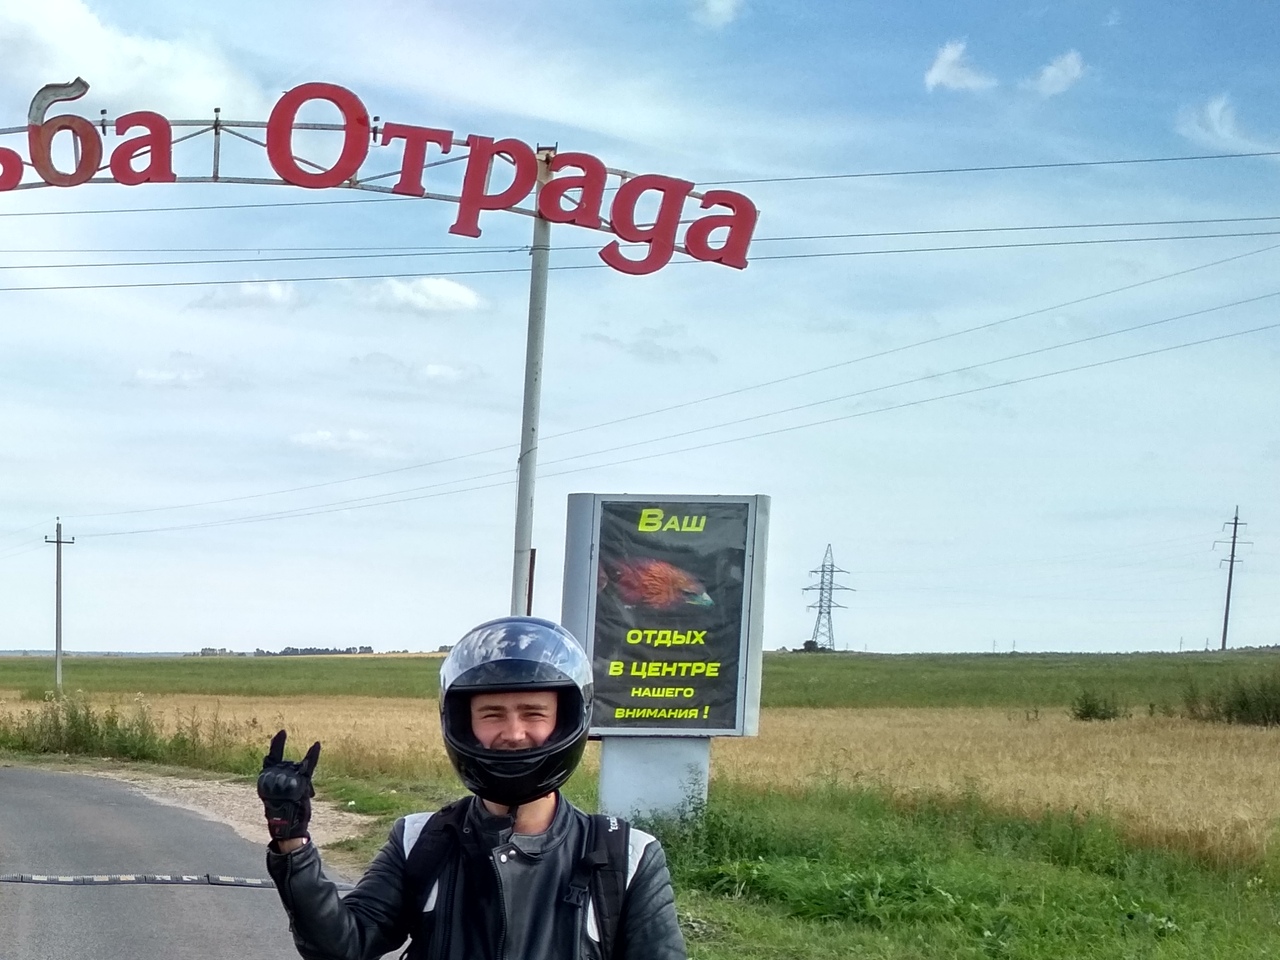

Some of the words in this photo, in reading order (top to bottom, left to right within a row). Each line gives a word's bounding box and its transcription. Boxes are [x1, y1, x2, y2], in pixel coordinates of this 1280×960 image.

[266, 82, 759, 275] Отрада
[626, 629, 708, 647] ОТДЫХ
[608, 661, 625, 676] В
[630, 662, 721, 679] ЦЕНТРЕ
[631, 687, 695, 697] НАШЕГО
[614, 708, 699, 719] ВНИМАНИЯ
